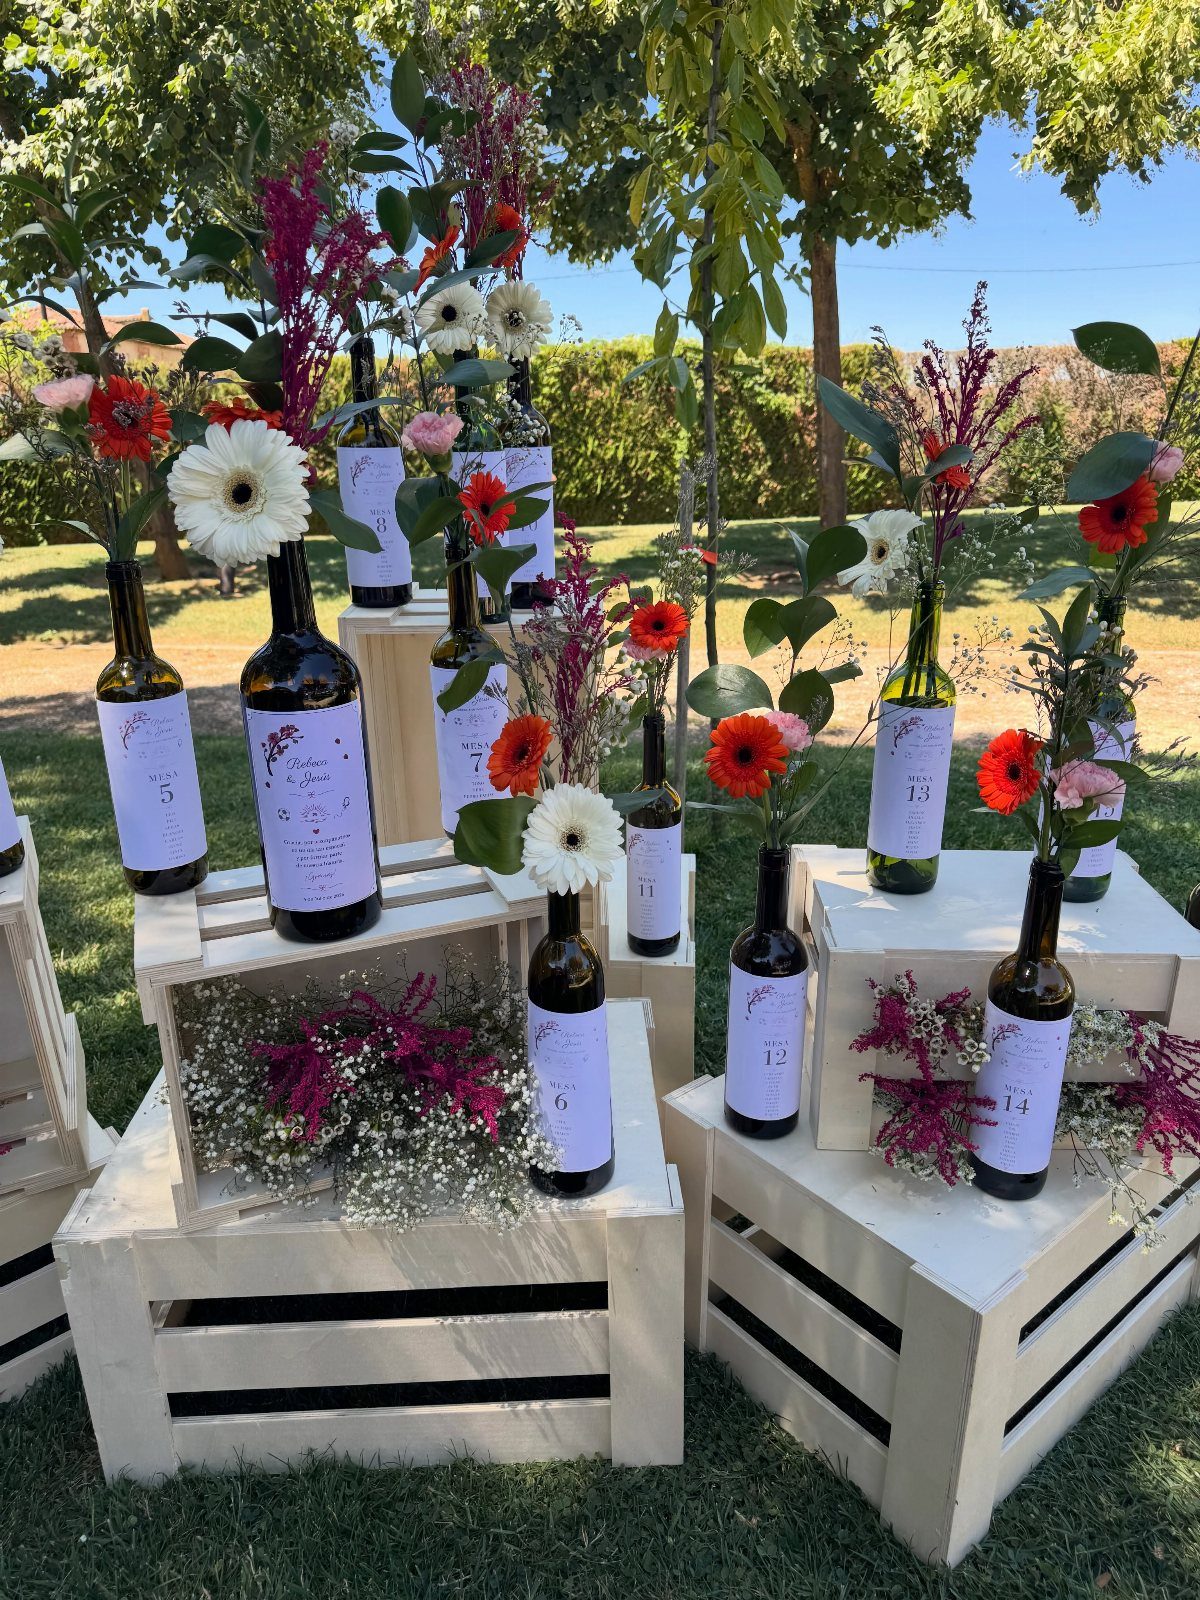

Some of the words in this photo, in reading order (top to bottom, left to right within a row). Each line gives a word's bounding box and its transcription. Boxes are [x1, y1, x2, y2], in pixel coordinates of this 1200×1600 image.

[376, 517, 387, 534] 8
[461, 741, 490, 750] MESA
[286, 756, 329, 770] Rebeca
[470, 752, 483, 773] 7
[148, 770, 178, 782] MESA
[286, 774, 296, 784] &
[299, 771, 332, 789] Jesús
[907, 775, 933, 783] MESA
[160, 782, 174, 804] 5
[905, 784, 930, 803] 13
[638, 883, 655, 898] 11
[763, 1048, 789, 1066] 12
[549, 1080, 577, 1091] MESA
[1003, 1084, 1033, 1096] MESA
[554, 1092, 568, 1111] 6
[1002, 1094, 1030, 1116] 14
